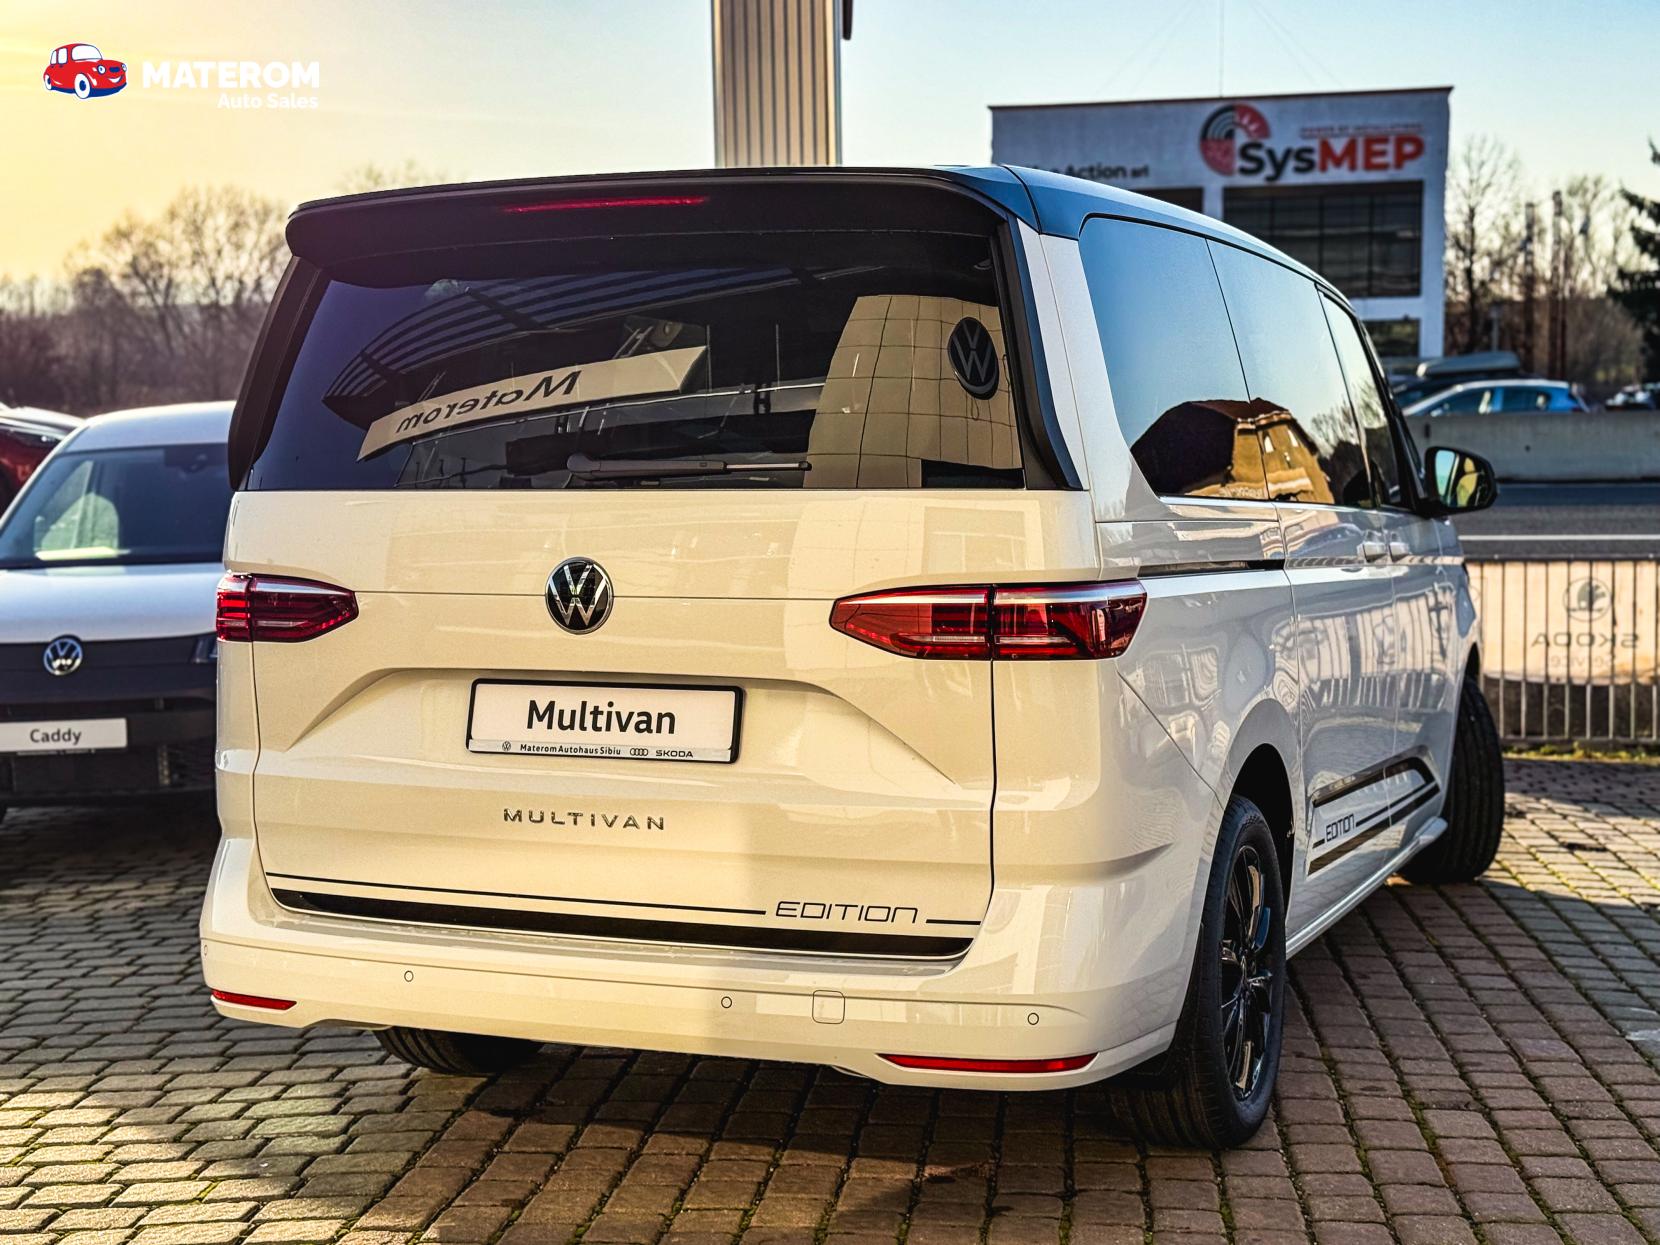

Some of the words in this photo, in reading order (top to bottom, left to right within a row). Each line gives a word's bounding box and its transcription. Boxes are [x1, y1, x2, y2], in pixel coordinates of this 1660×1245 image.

[1238, 134, 1425, 183] SysMEP
[1064, 162, 1127, 180] Action
[526, 700, 676, 734] Multivan
[30, 728, 82, 745] Caddy
[520, 743, 557, 753] Materom
[558, 745, 599, 755] Autohaus
[600, 746, 621, 756] Sibiu
[656, 750, 694, 758] SKODA
[503, 807, 664, 831] MULTIVAN
[775, 900, 919, 924] EDITION
